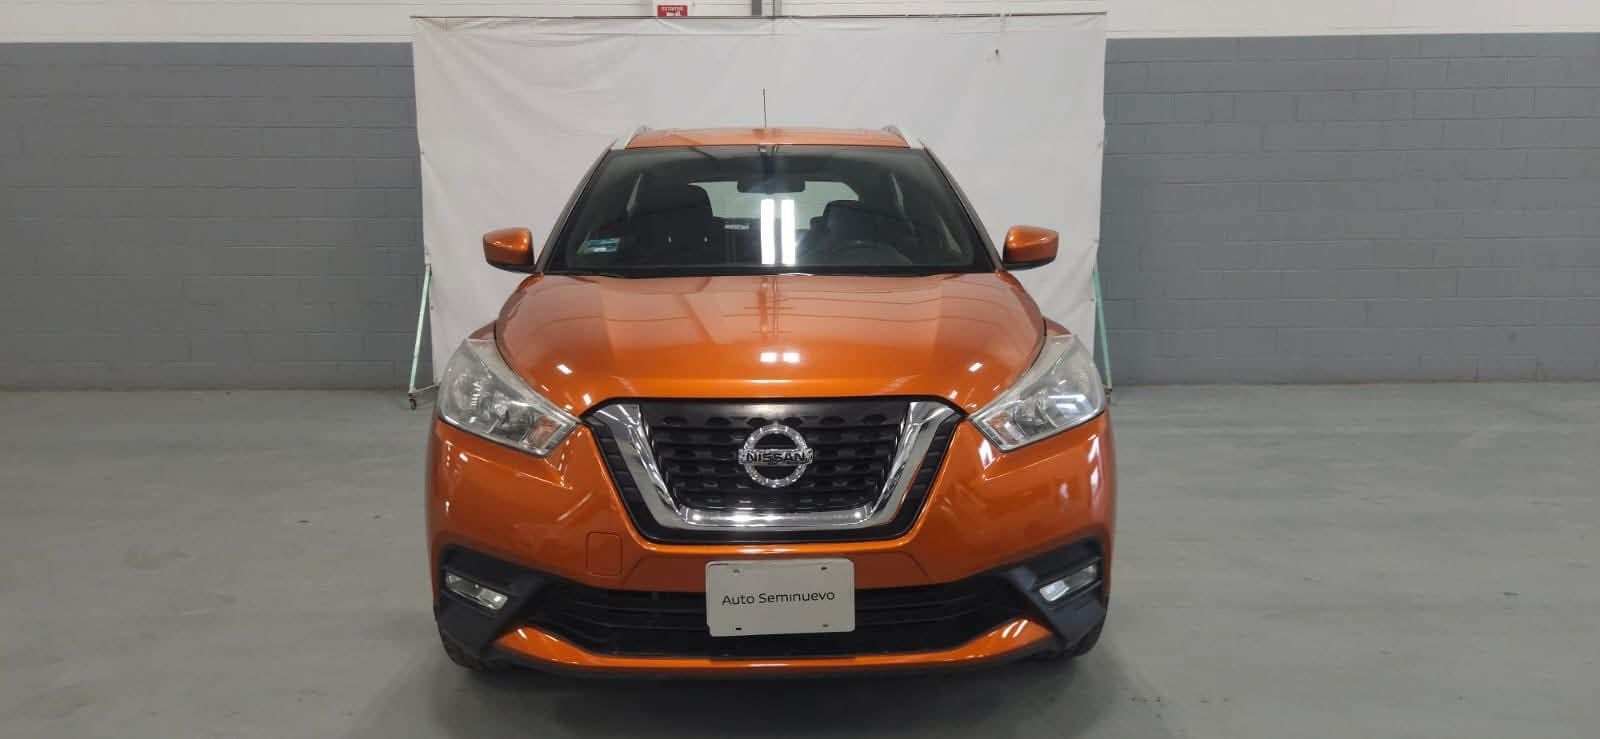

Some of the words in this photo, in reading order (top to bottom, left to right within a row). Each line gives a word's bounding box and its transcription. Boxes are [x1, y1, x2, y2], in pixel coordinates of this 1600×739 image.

[745, 452, 806, 464] NISSAN
[721, 594, 755, 606] Auto
[758, 591, 835, 604] Seminuevo
